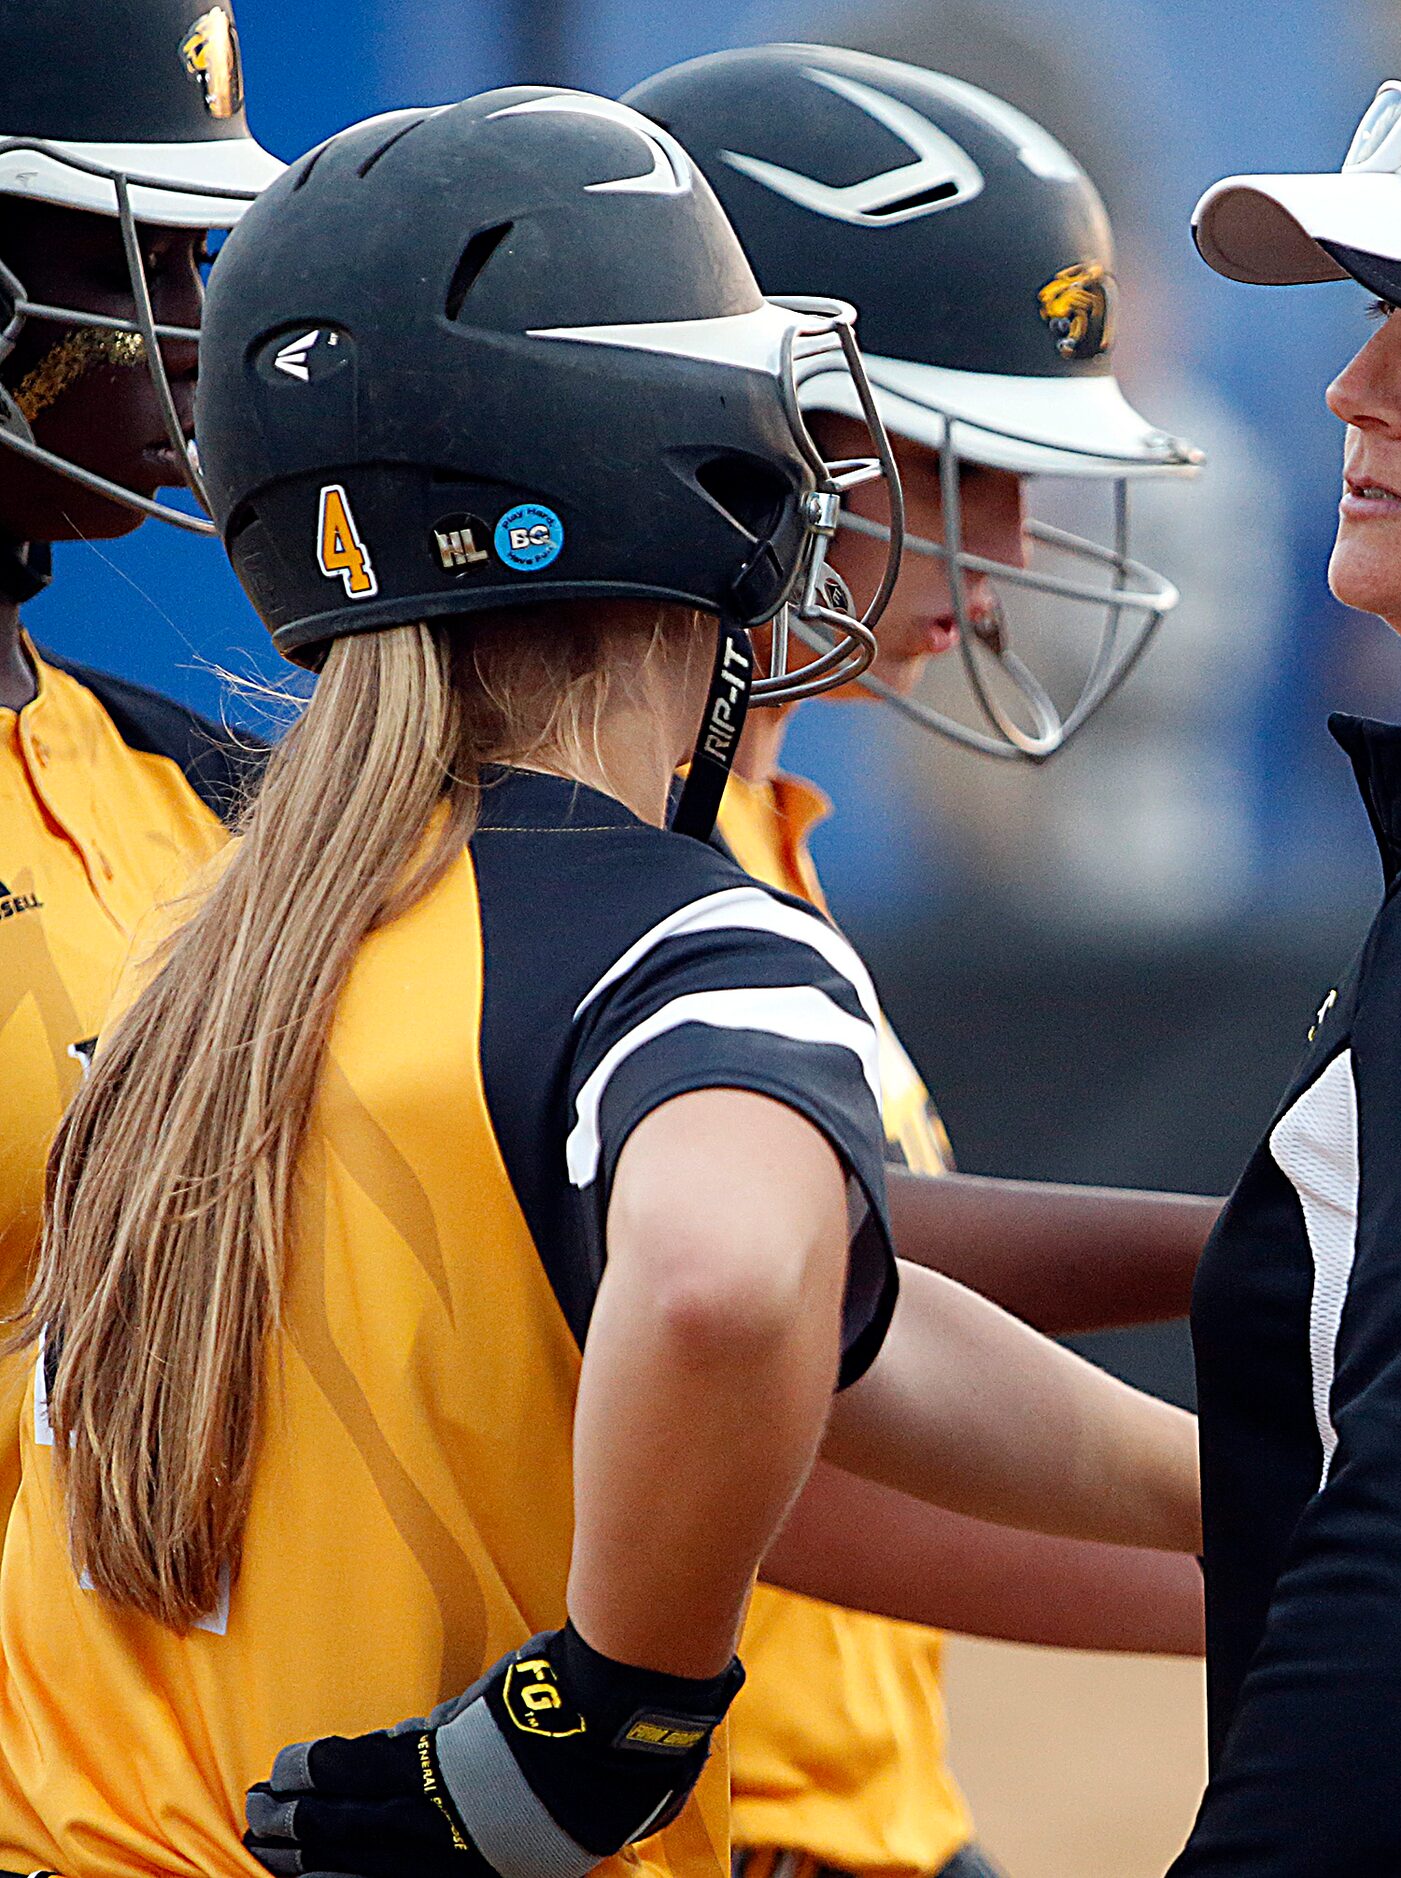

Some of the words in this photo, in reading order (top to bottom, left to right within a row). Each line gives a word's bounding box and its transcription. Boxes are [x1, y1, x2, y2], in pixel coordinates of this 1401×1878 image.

[316, 485, 378, 599] 4
[502, 510, 523, 529] Play
[434, 529, 489, 568] HL
[704, 637, 749, 762] RIP-IT
[0, 893, 44, 919] SELL
[515, 1659, 561, 1710] FG
